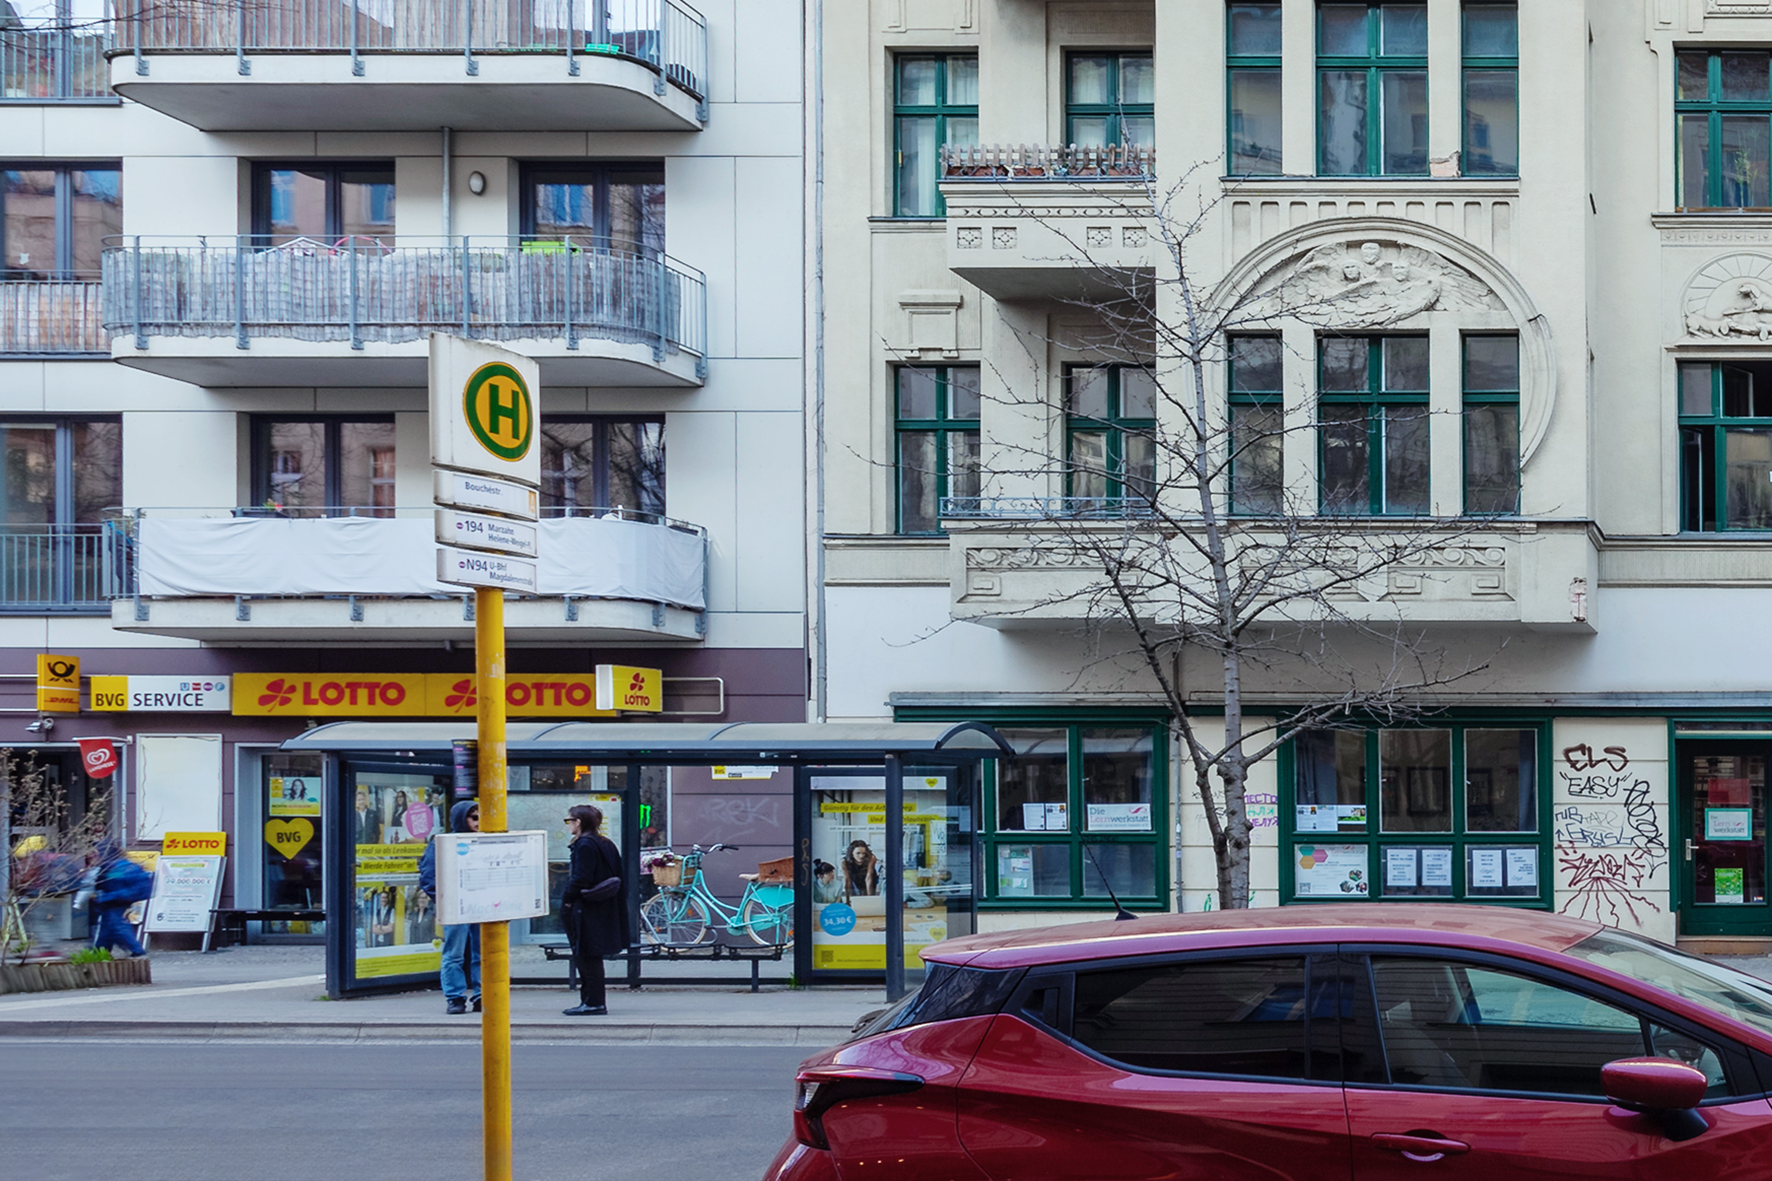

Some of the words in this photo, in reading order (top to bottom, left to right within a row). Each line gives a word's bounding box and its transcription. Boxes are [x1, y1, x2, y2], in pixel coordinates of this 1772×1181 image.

[488, 382, 519, 440] H
[465, 521, 483, 533] 194
[488, 523, 514, 535] Marzahn
[466, 559, 487, 572] N94
[95, 693, 124, 707] BVG
[133, 693, 204, 707] SERVICE
[303, 681, 406, 707] LOTTO
[505, 681, 592, 707] OTTO
[624, 693, 650, 707] LOTTO
[1090, 807, 1106, 815] Die
[182, 839, 220, 849] LOTTO
[276, 831, 301, 843] BVG
